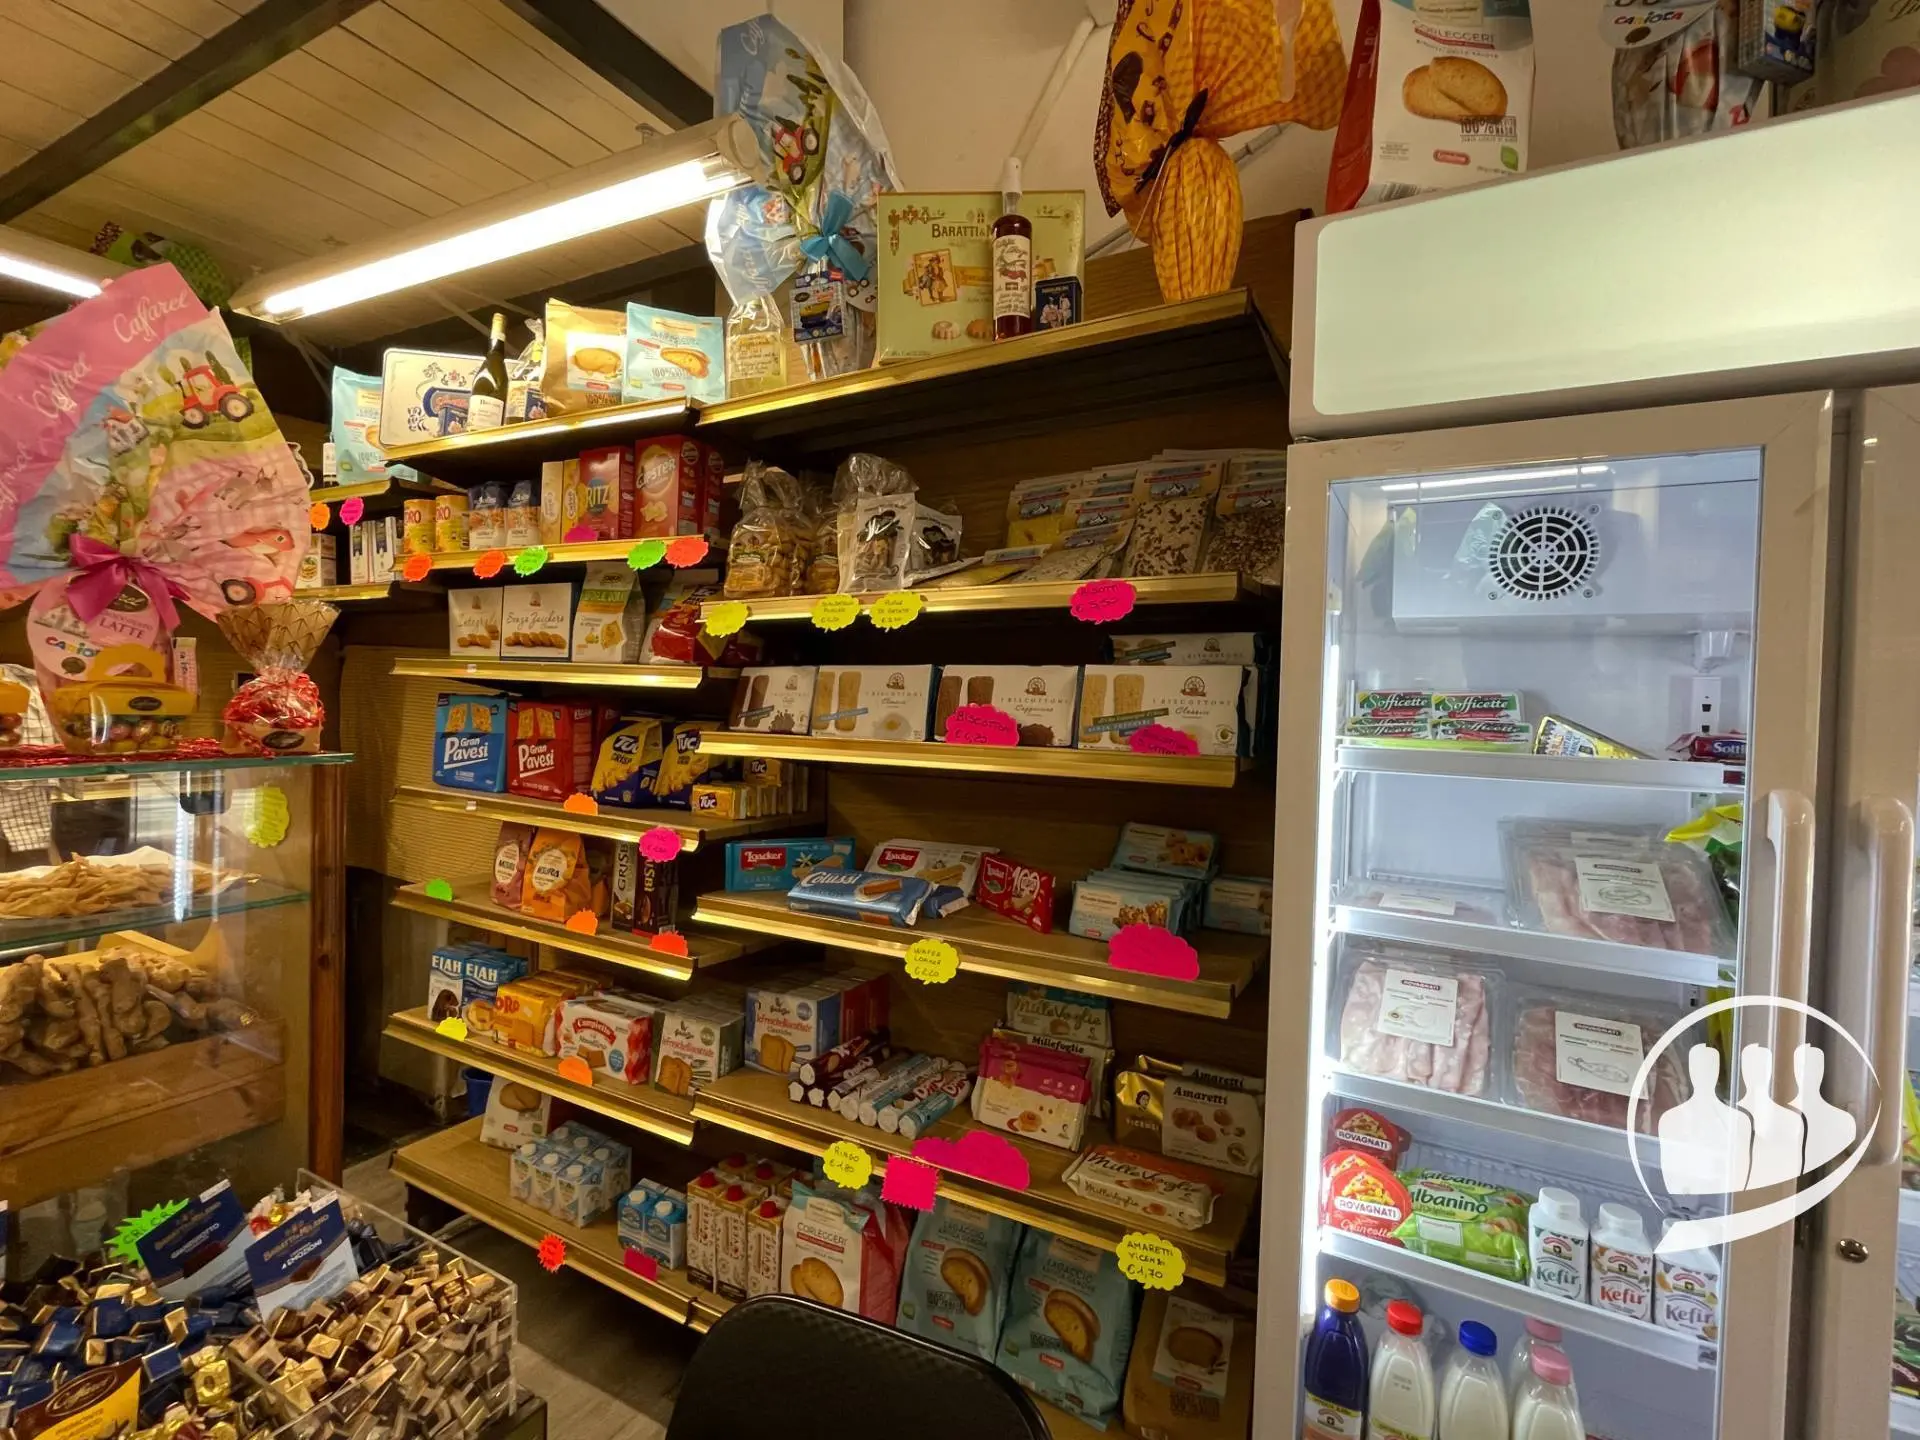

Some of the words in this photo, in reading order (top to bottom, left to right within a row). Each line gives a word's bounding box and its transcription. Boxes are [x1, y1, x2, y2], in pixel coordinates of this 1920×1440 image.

[1614, 10, 1683, 25] CARIOCA
[932, 223, 979, 239] BARATTI
[587, 485, 609, 507] RITZ
[99, 616, 146, 640] LATTE
[444, 736, 489, 763] Pavesi
[460, 737, 480, 746] Gran
[529, 744, 547, 754] Gran
[676, 733, 697, 749] TUC
[518, 744, 555, 771] Pavesi
[751, 760, 766, 774] TUC
[700, 795, 716, 809] TUC
[801, 871, 862, 888] Colussi
[432, 955, 462, 974] ELAH
[466, 963, 498, 982] ELAH
[1173, 1086, 1228, 1106] Amaretti
[1338, 1130, 1388, 1149] ROVAGNATI
[1339, 1199, 1397, 1219] ROVAGNATI
[1536, 1265, 1579, 1285] Kefir
[1600, 1285, 1645, 1305] Kefir
[1665, 1304, 1714, 1324] Kefir
